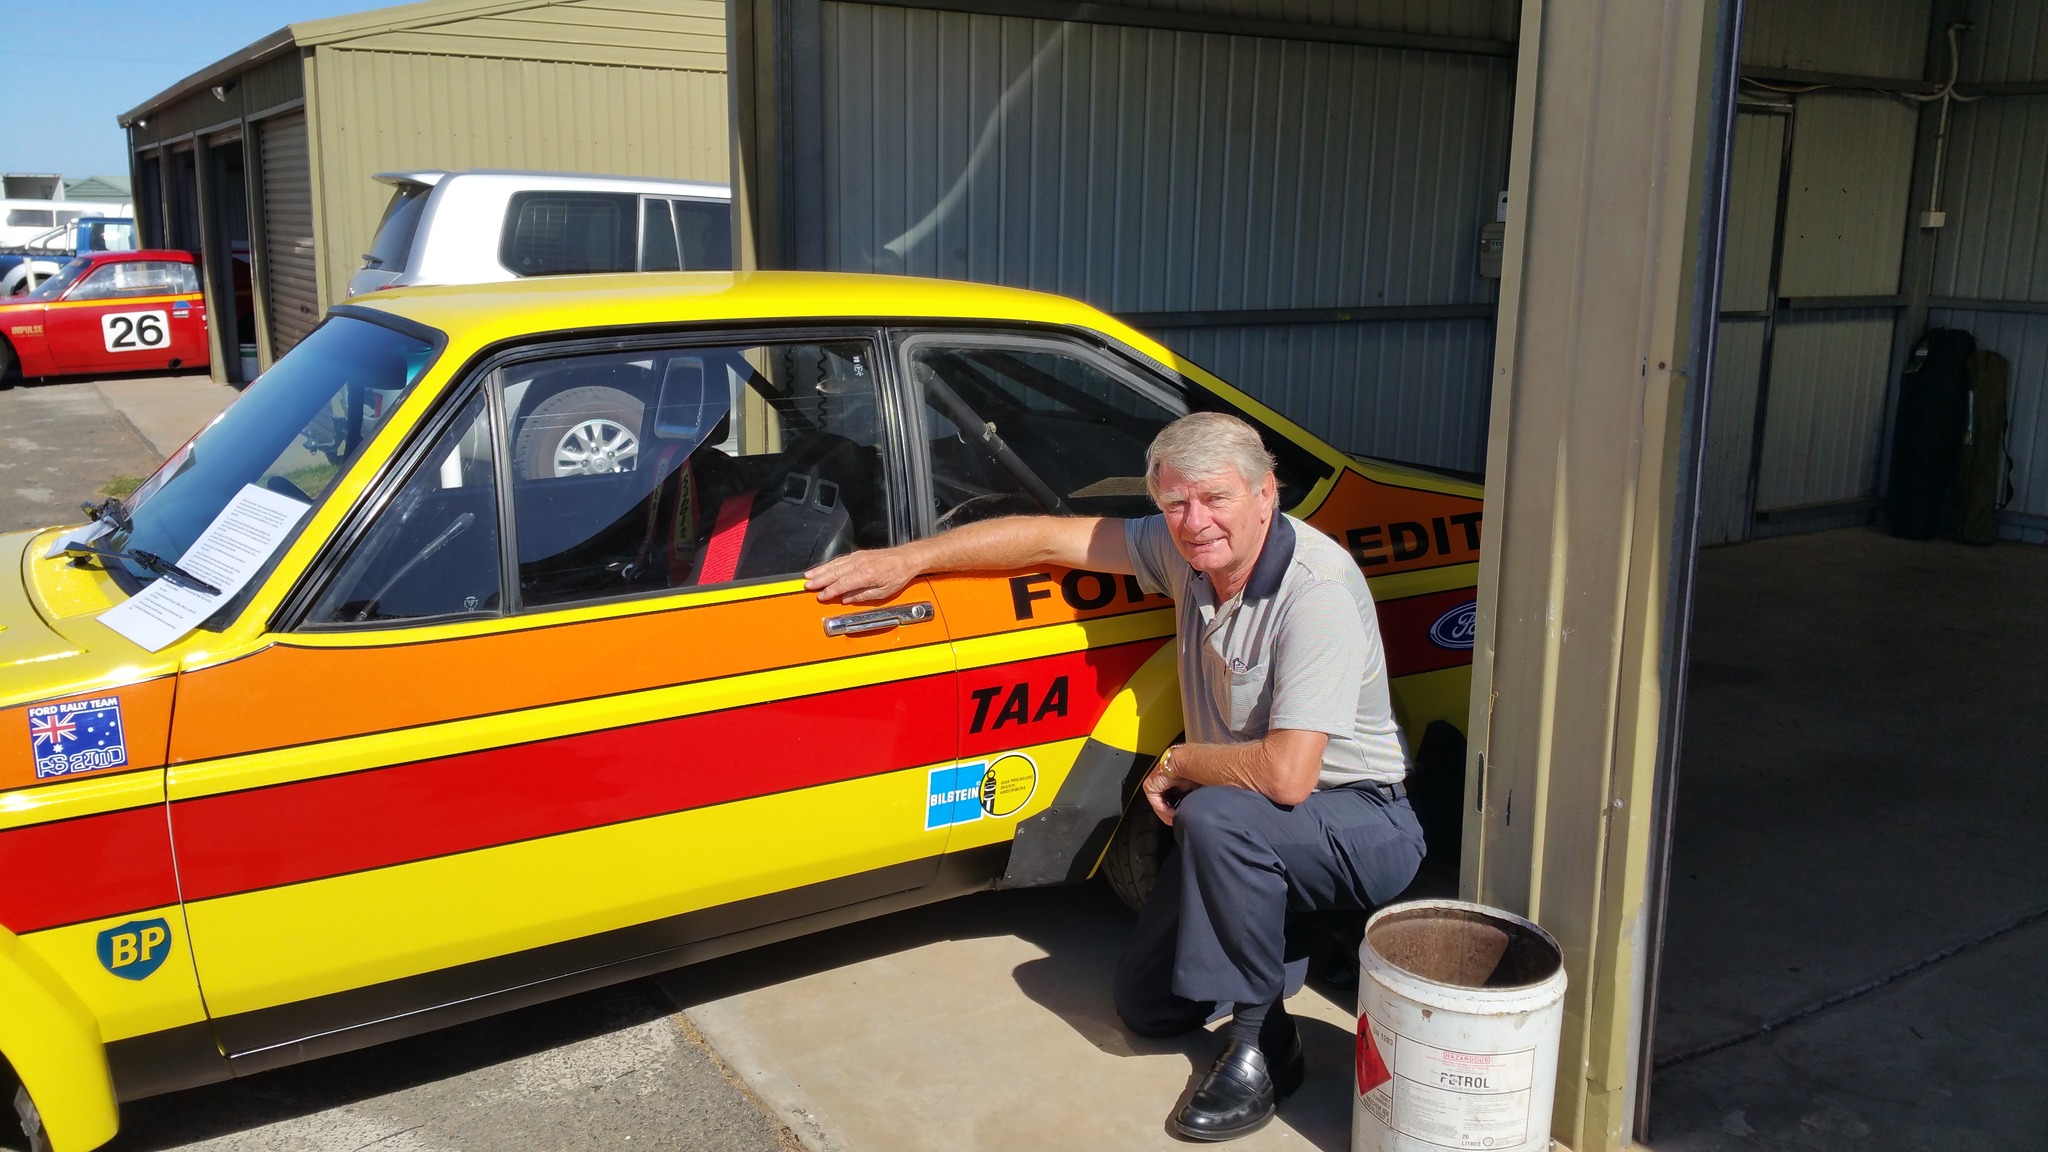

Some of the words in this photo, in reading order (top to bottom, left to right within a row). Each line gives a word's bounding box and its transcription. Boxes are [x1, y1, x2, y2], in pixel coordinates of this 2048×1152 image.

[11, 325, 44, 336] IMPULSE
[109, 314, 164, 349] 26
[1327, 511, 1483, 567] EDIT
[29, 705, 58, 718] FORD
[60, 701, 89, 713] RALLY
[90, 697, 118, 709] TEAM
[968, 675, 1070, 735] TAA
[930, 786, 980, 807] BILSTEIN
[110, 926, 166, 970] BP
[1445, 1053, 1490, 1063] HAZARDOUS
[1440, 1072, 1490, 1089] PETROL
